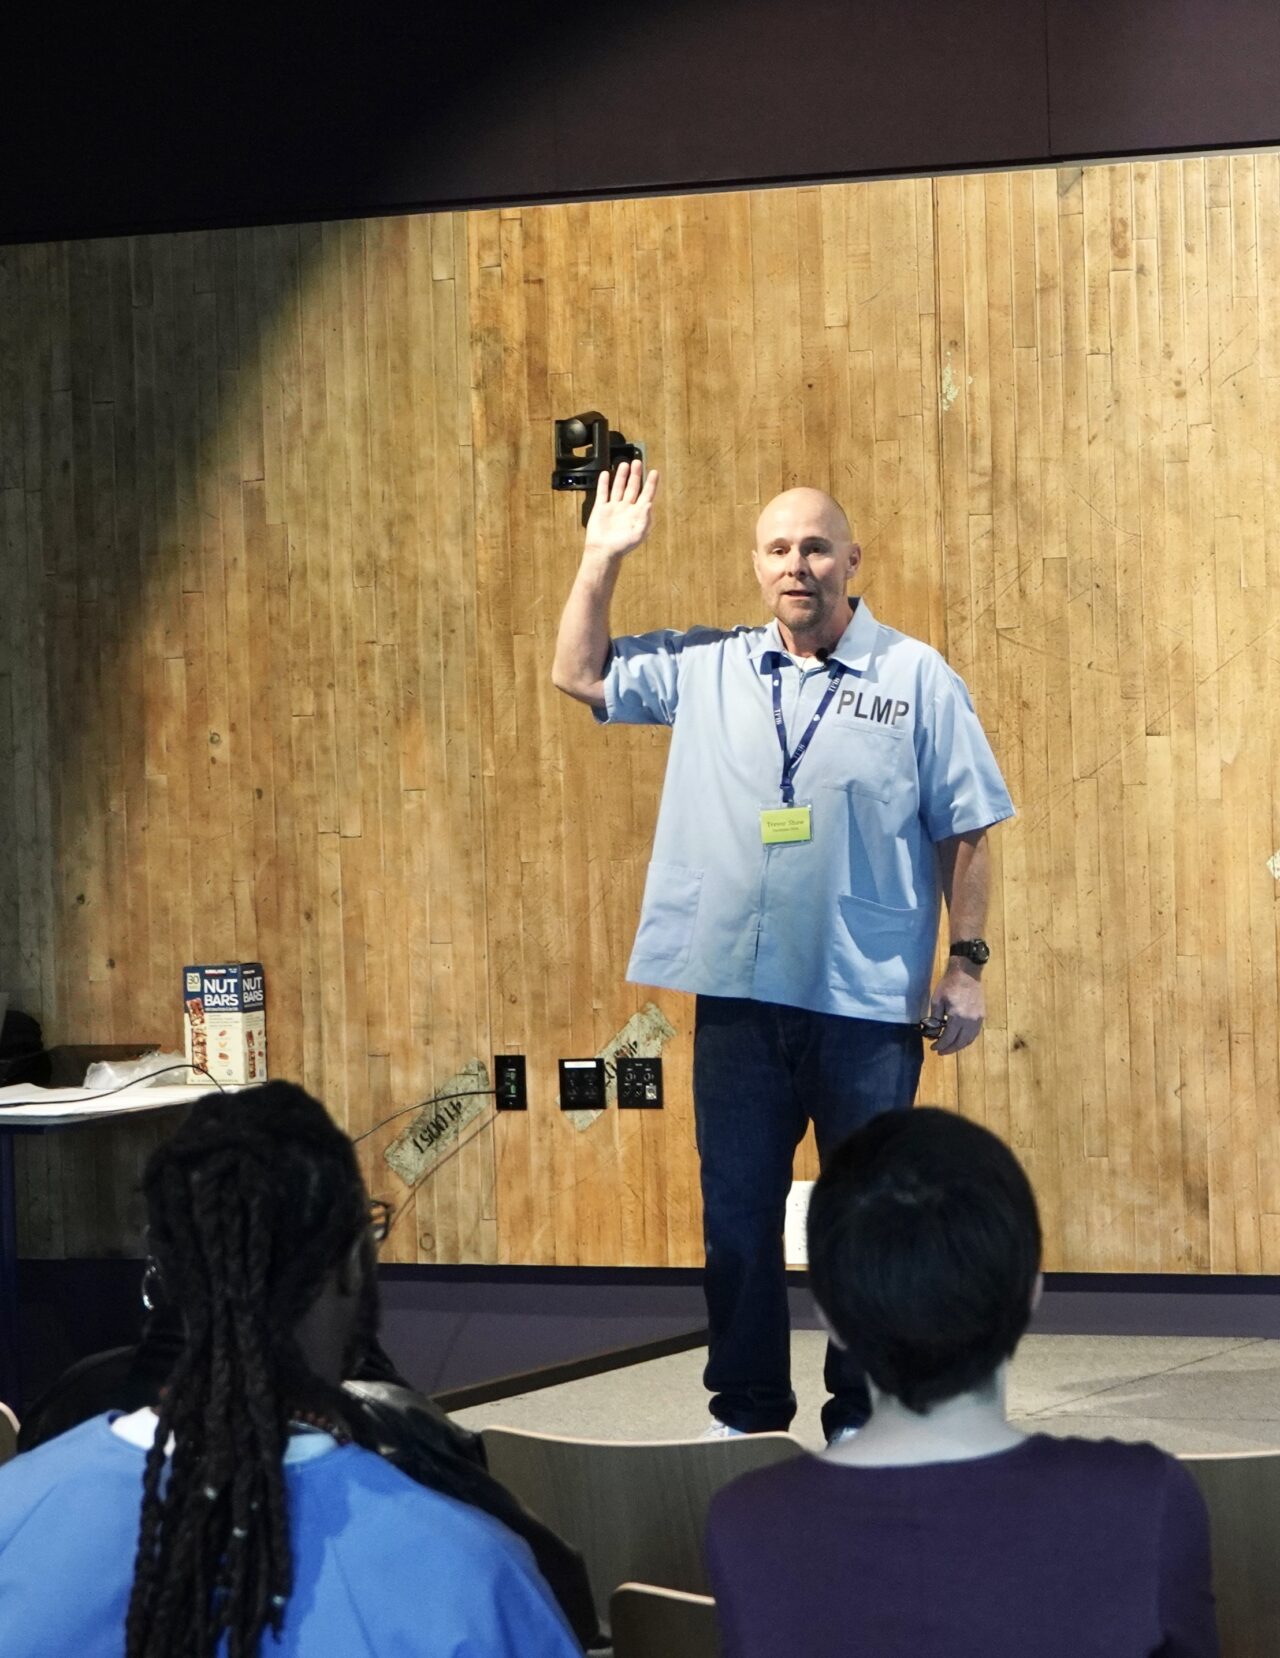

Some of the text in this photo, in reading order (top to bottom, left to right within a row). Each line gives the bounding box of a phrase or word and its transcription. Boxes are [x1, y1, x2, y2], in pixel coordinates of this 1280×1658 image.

[836, 690, 911, 727] PLMP
[188, 975, 199, 985] 30
[204, 979, 238, 993] NUT
[242, 977, 262, 991] NUT
[204, 994, 239, 1006] BARS
[243, 990, 264, 1003] BARS
